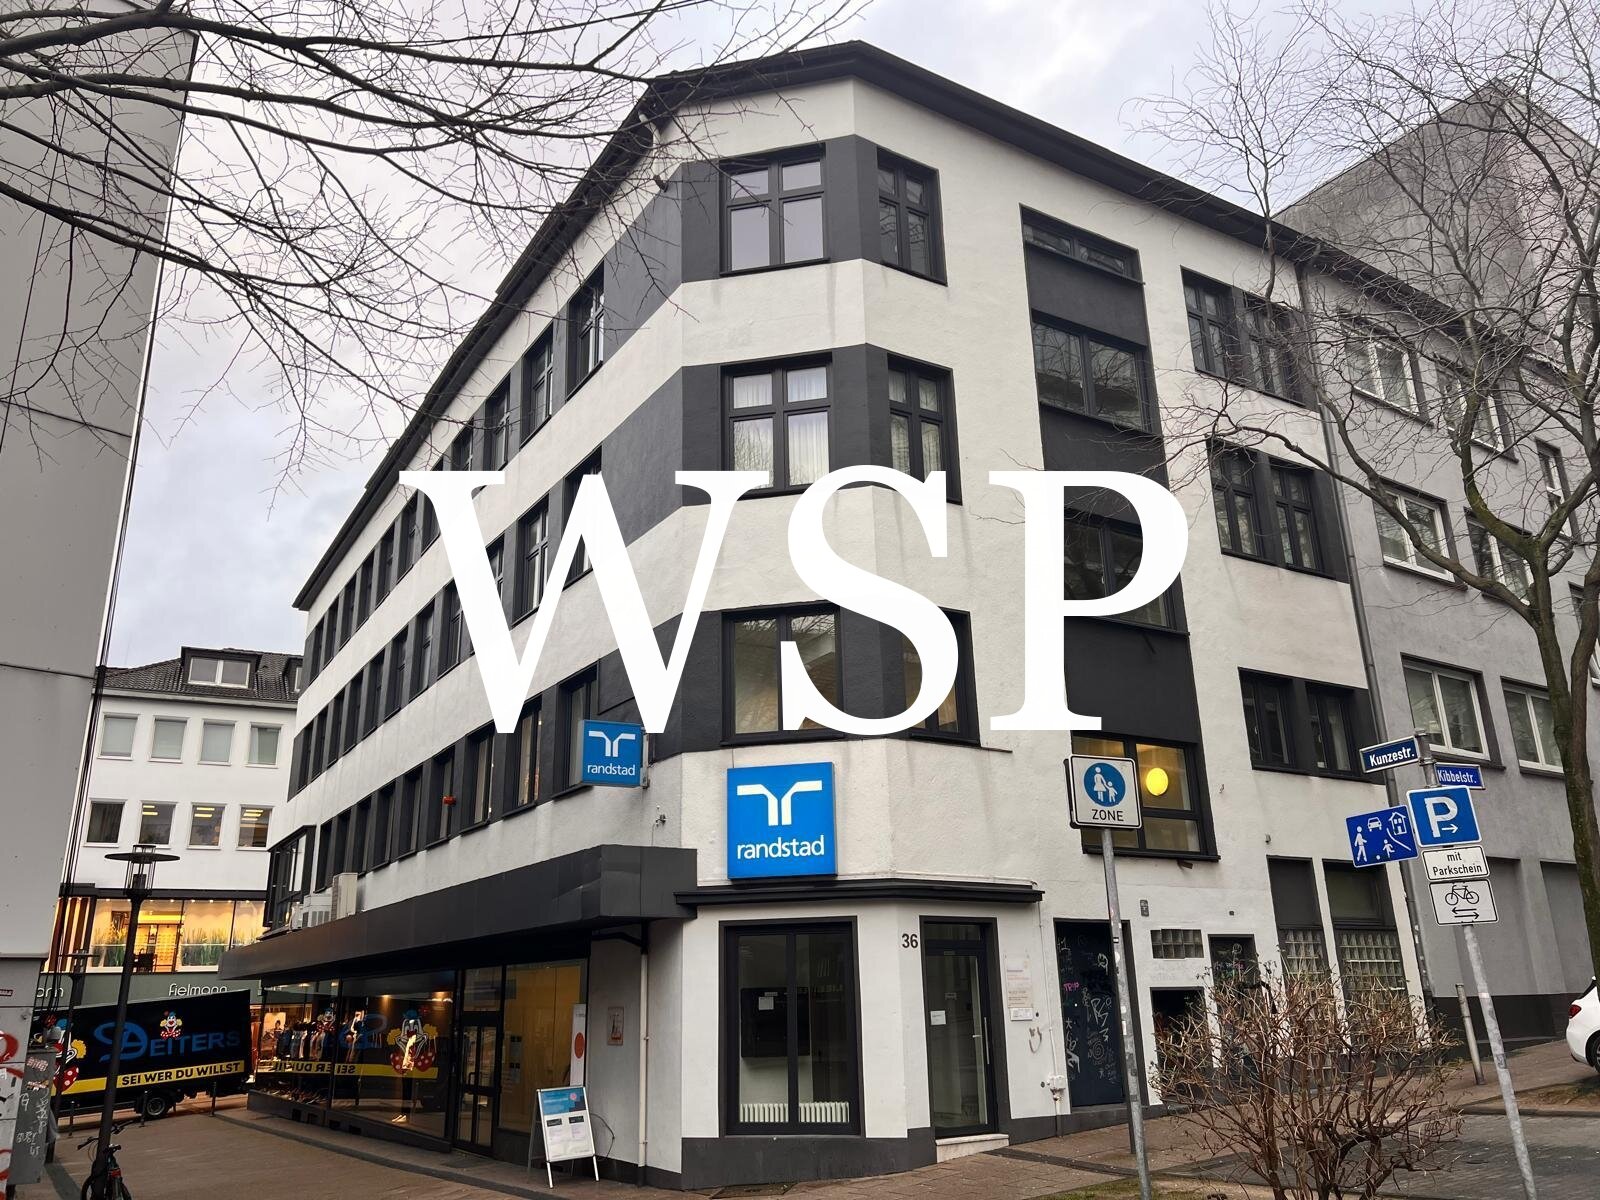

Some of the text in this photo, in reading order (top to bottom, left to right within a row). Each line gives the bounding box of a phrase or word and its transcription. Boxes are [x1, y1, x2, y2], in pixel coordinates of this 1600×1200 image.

[1369, 746, 1415, 767] Kunzestr.
[587, 762, 636, 776] randstad
[1437, 769, 1477, 784] Kibbelstr.
[1091, 808, 1124, 822] ZONE
[1424, 796, 1459, 838] P
[736, 834, 825, 860] randstad
[1446, 851, 1463, 862] mit
[1432, 863, 1483, 876] Parkschein
[901, 933, 919, 949] 36
[121, 1062, 241, 1086] SEI WER DU WILLST
